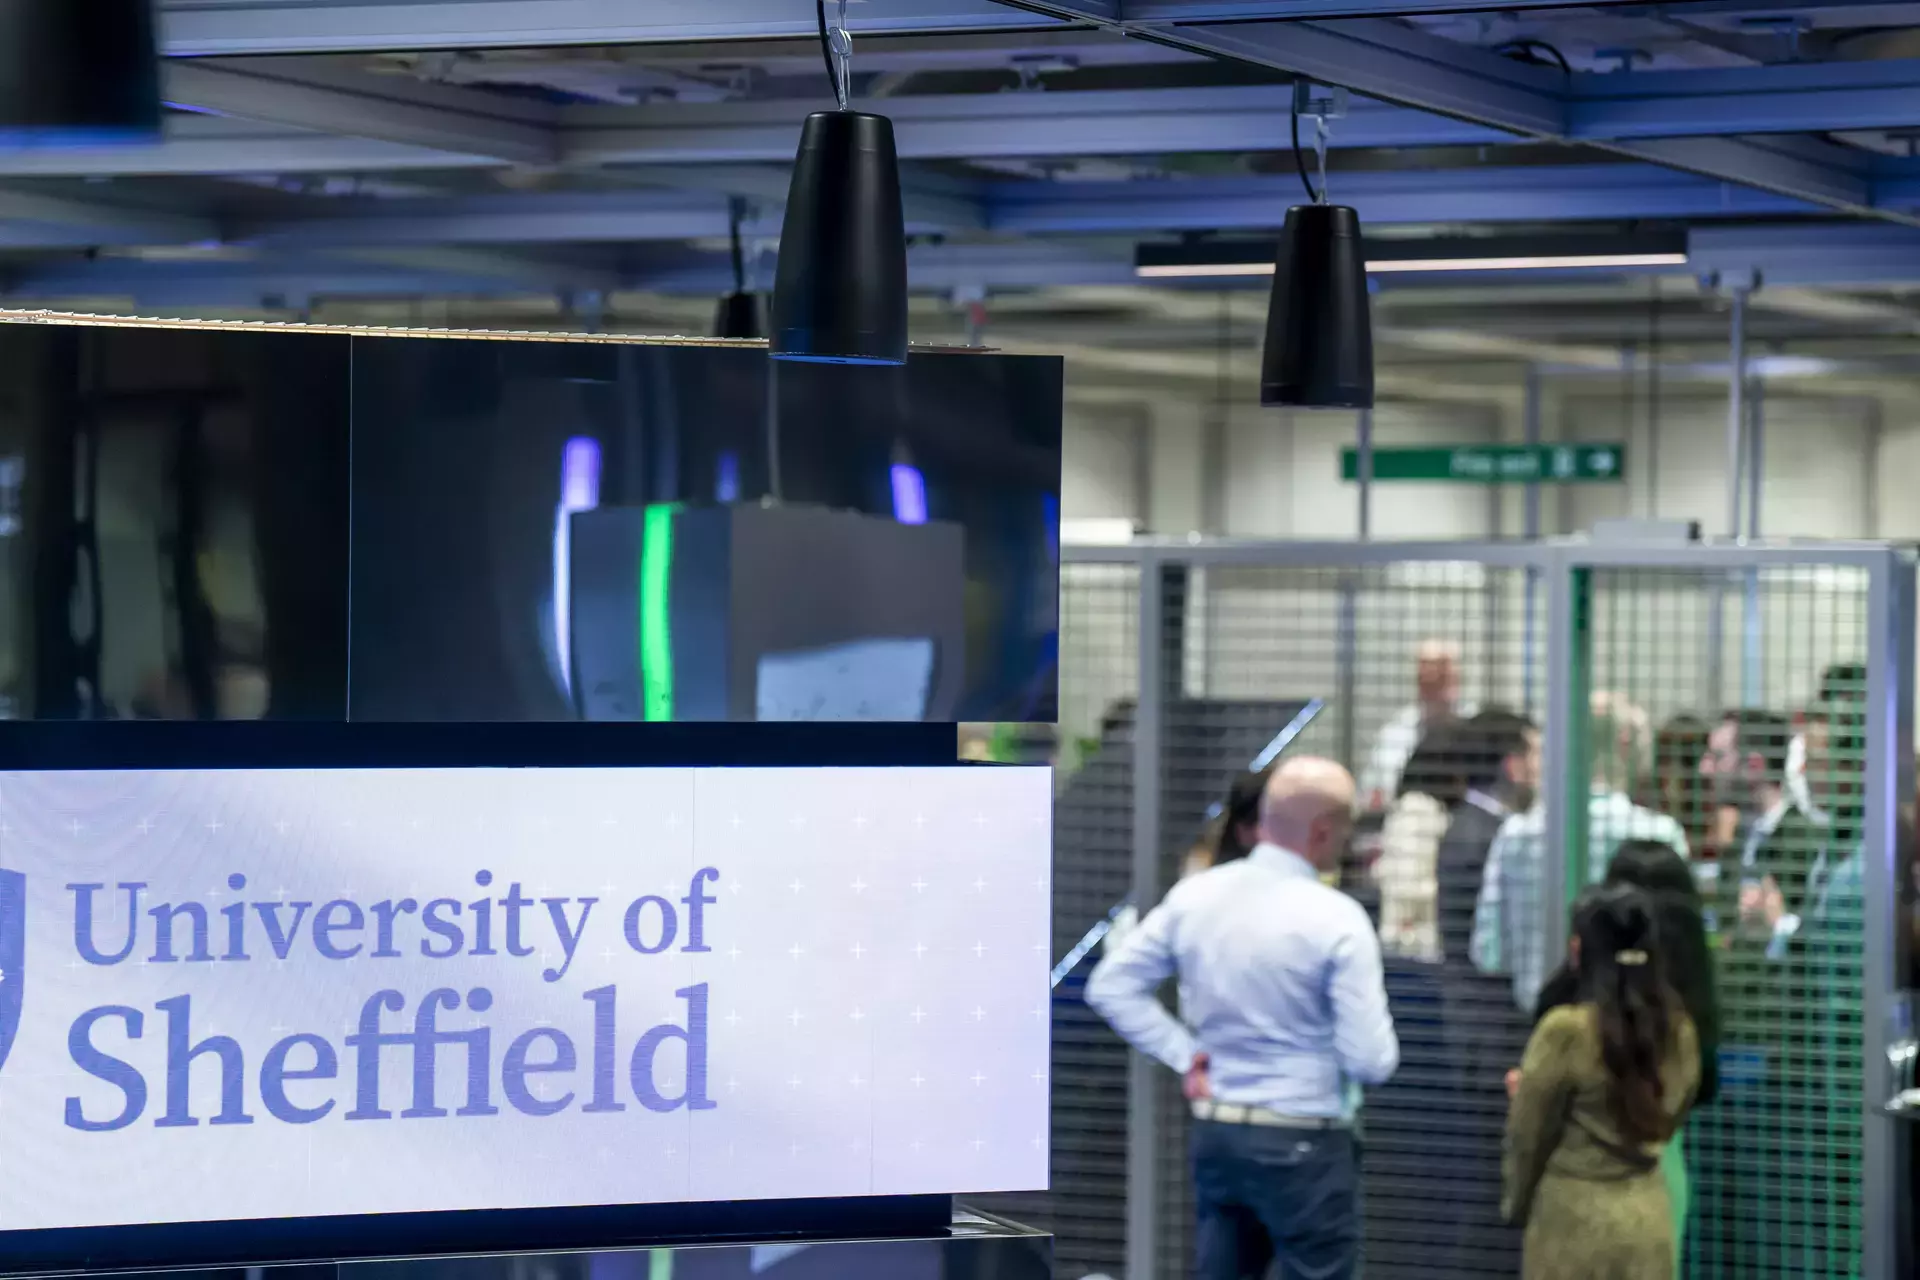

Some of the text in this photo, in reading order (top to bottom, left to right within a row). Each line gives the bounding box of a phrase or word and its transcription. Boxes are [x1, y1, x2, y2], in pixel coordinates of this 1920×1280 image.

[66, 867, 720, 982] University of
[64, 983, 719, 1133] Sheffield
